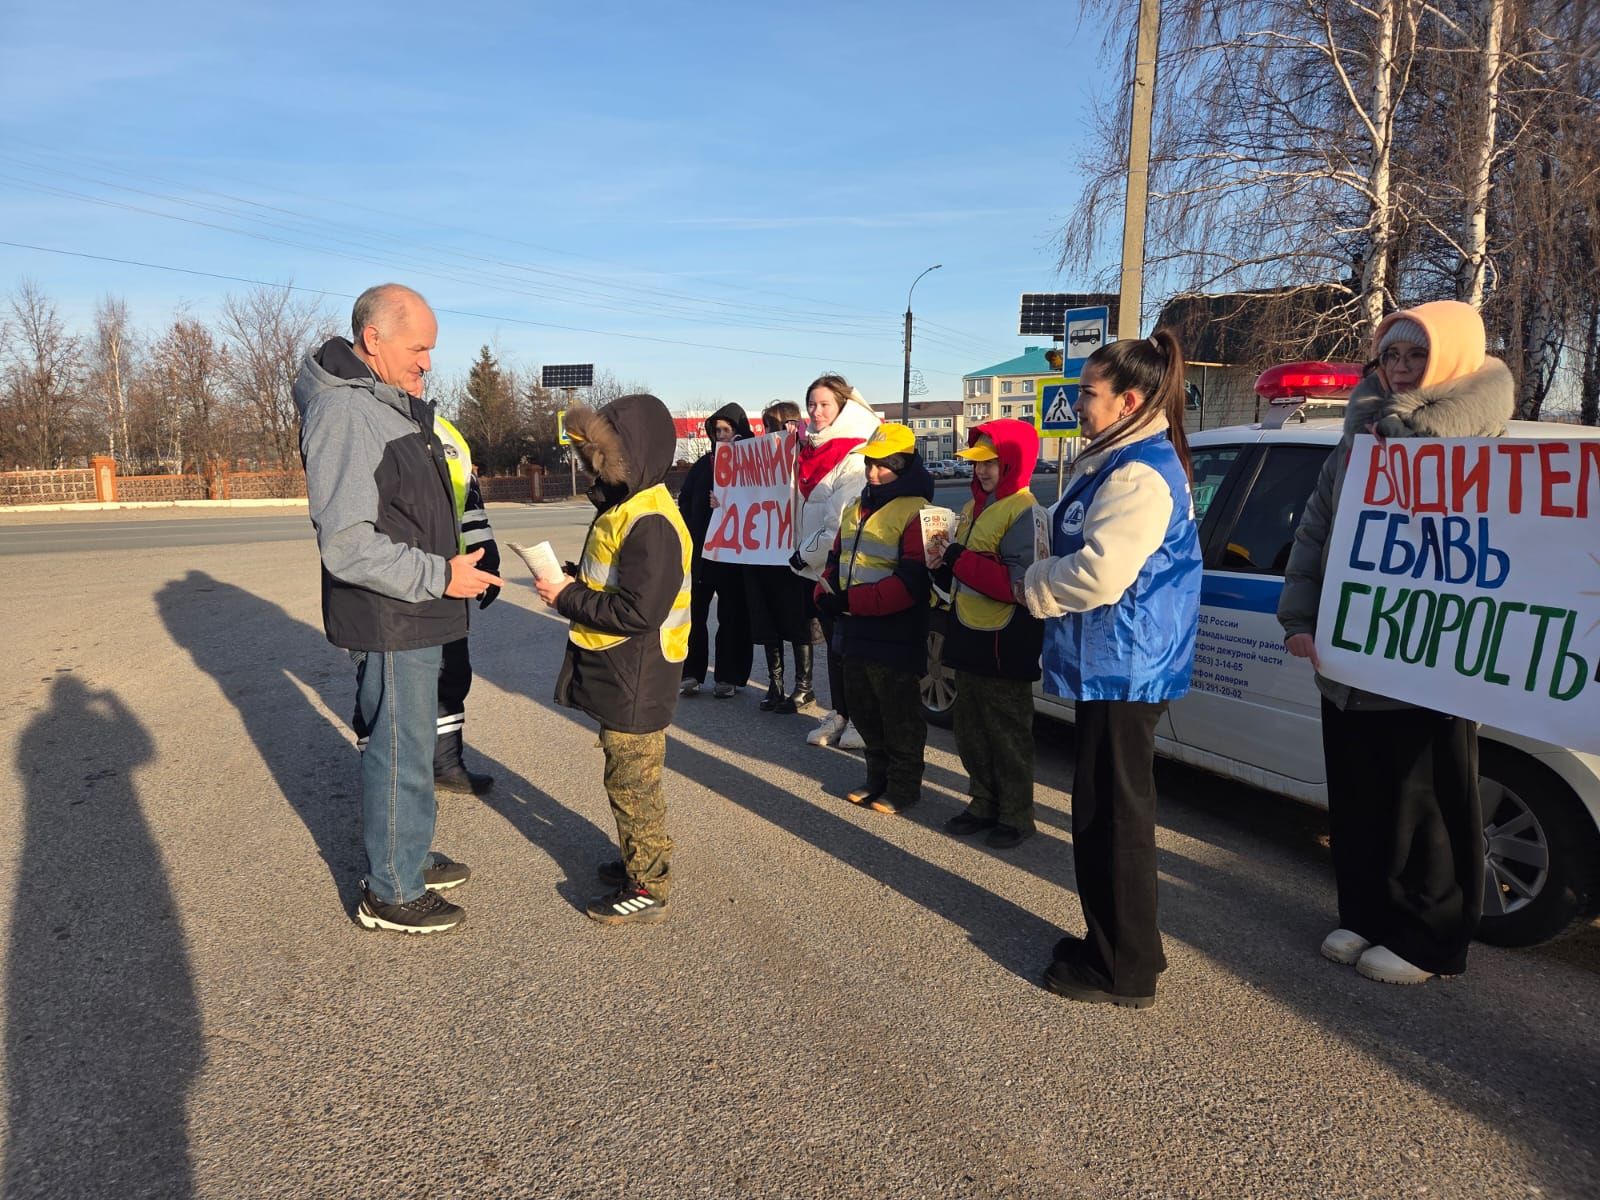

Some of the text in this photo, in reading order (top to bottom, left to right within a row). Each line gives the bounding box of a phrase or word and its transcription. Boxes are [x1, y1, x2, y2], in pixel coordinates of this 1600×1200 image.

[704, 500, 793, 554] ДЕТИ
[1349, 510, 1511, 589] СБАВЬ
[1210, 616, 1239, 629] России
[1259, 640, 1289, 654] району
[1331, 581, 1589, 701] СКОРОСТЬ
[1216, 647, 1256, 660] дежурной
[1258, 655, 1283, 665] части
[1215, 659, 1243, 671] 3-14-65
[1215, 673, 1249, 687] доверия
[1206, 682, 1242, 699] 291-20-02
